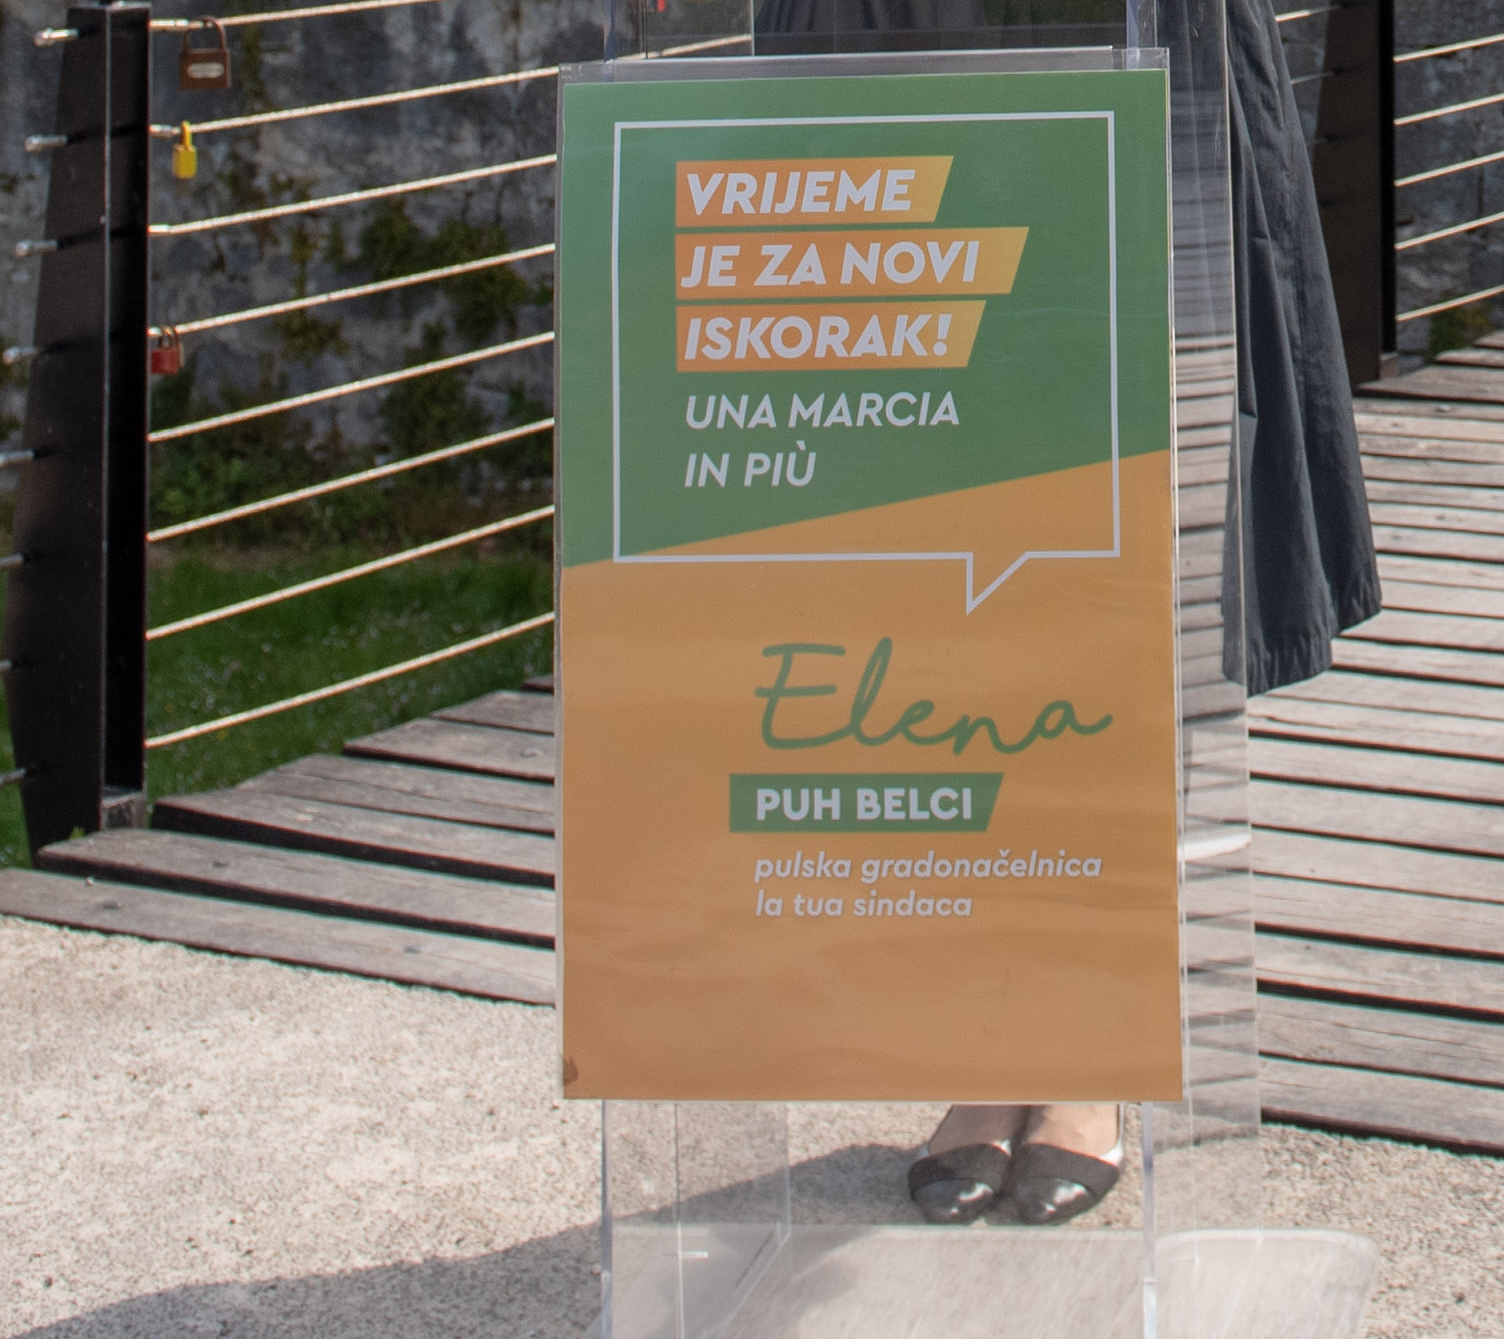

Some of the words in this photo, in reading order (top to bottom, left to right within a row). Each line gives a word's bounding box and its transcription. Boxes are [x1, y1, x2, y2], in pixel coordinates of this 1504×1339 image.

[686, 169, 916, 216] VRIJEME
[681, 245, 741, 288] JE
[753, 243, 827, 287] ZA
[840, 241, 981, 285] NOVI
[684, 314, 953, 360] ISKORAK!
[685, 394, 778, 429] UNA
[788, 391, 961, 428] MARCIA
[684, 453, 730, 487] IN
[744, 440, 817, 487] PIÙ
[754, 637, 1114, 755] Elena
[756, 788, 841, 821] PUH
[856, 787, 973, 821] BELCI
[754, 851, 852, 884] pulska
[861, 849, 1103, 884] gradonačelnica
[756, 890, 783, 917] la
[793, 893, 843, 917] tua
[853, 889, 973, 917] sindaca
